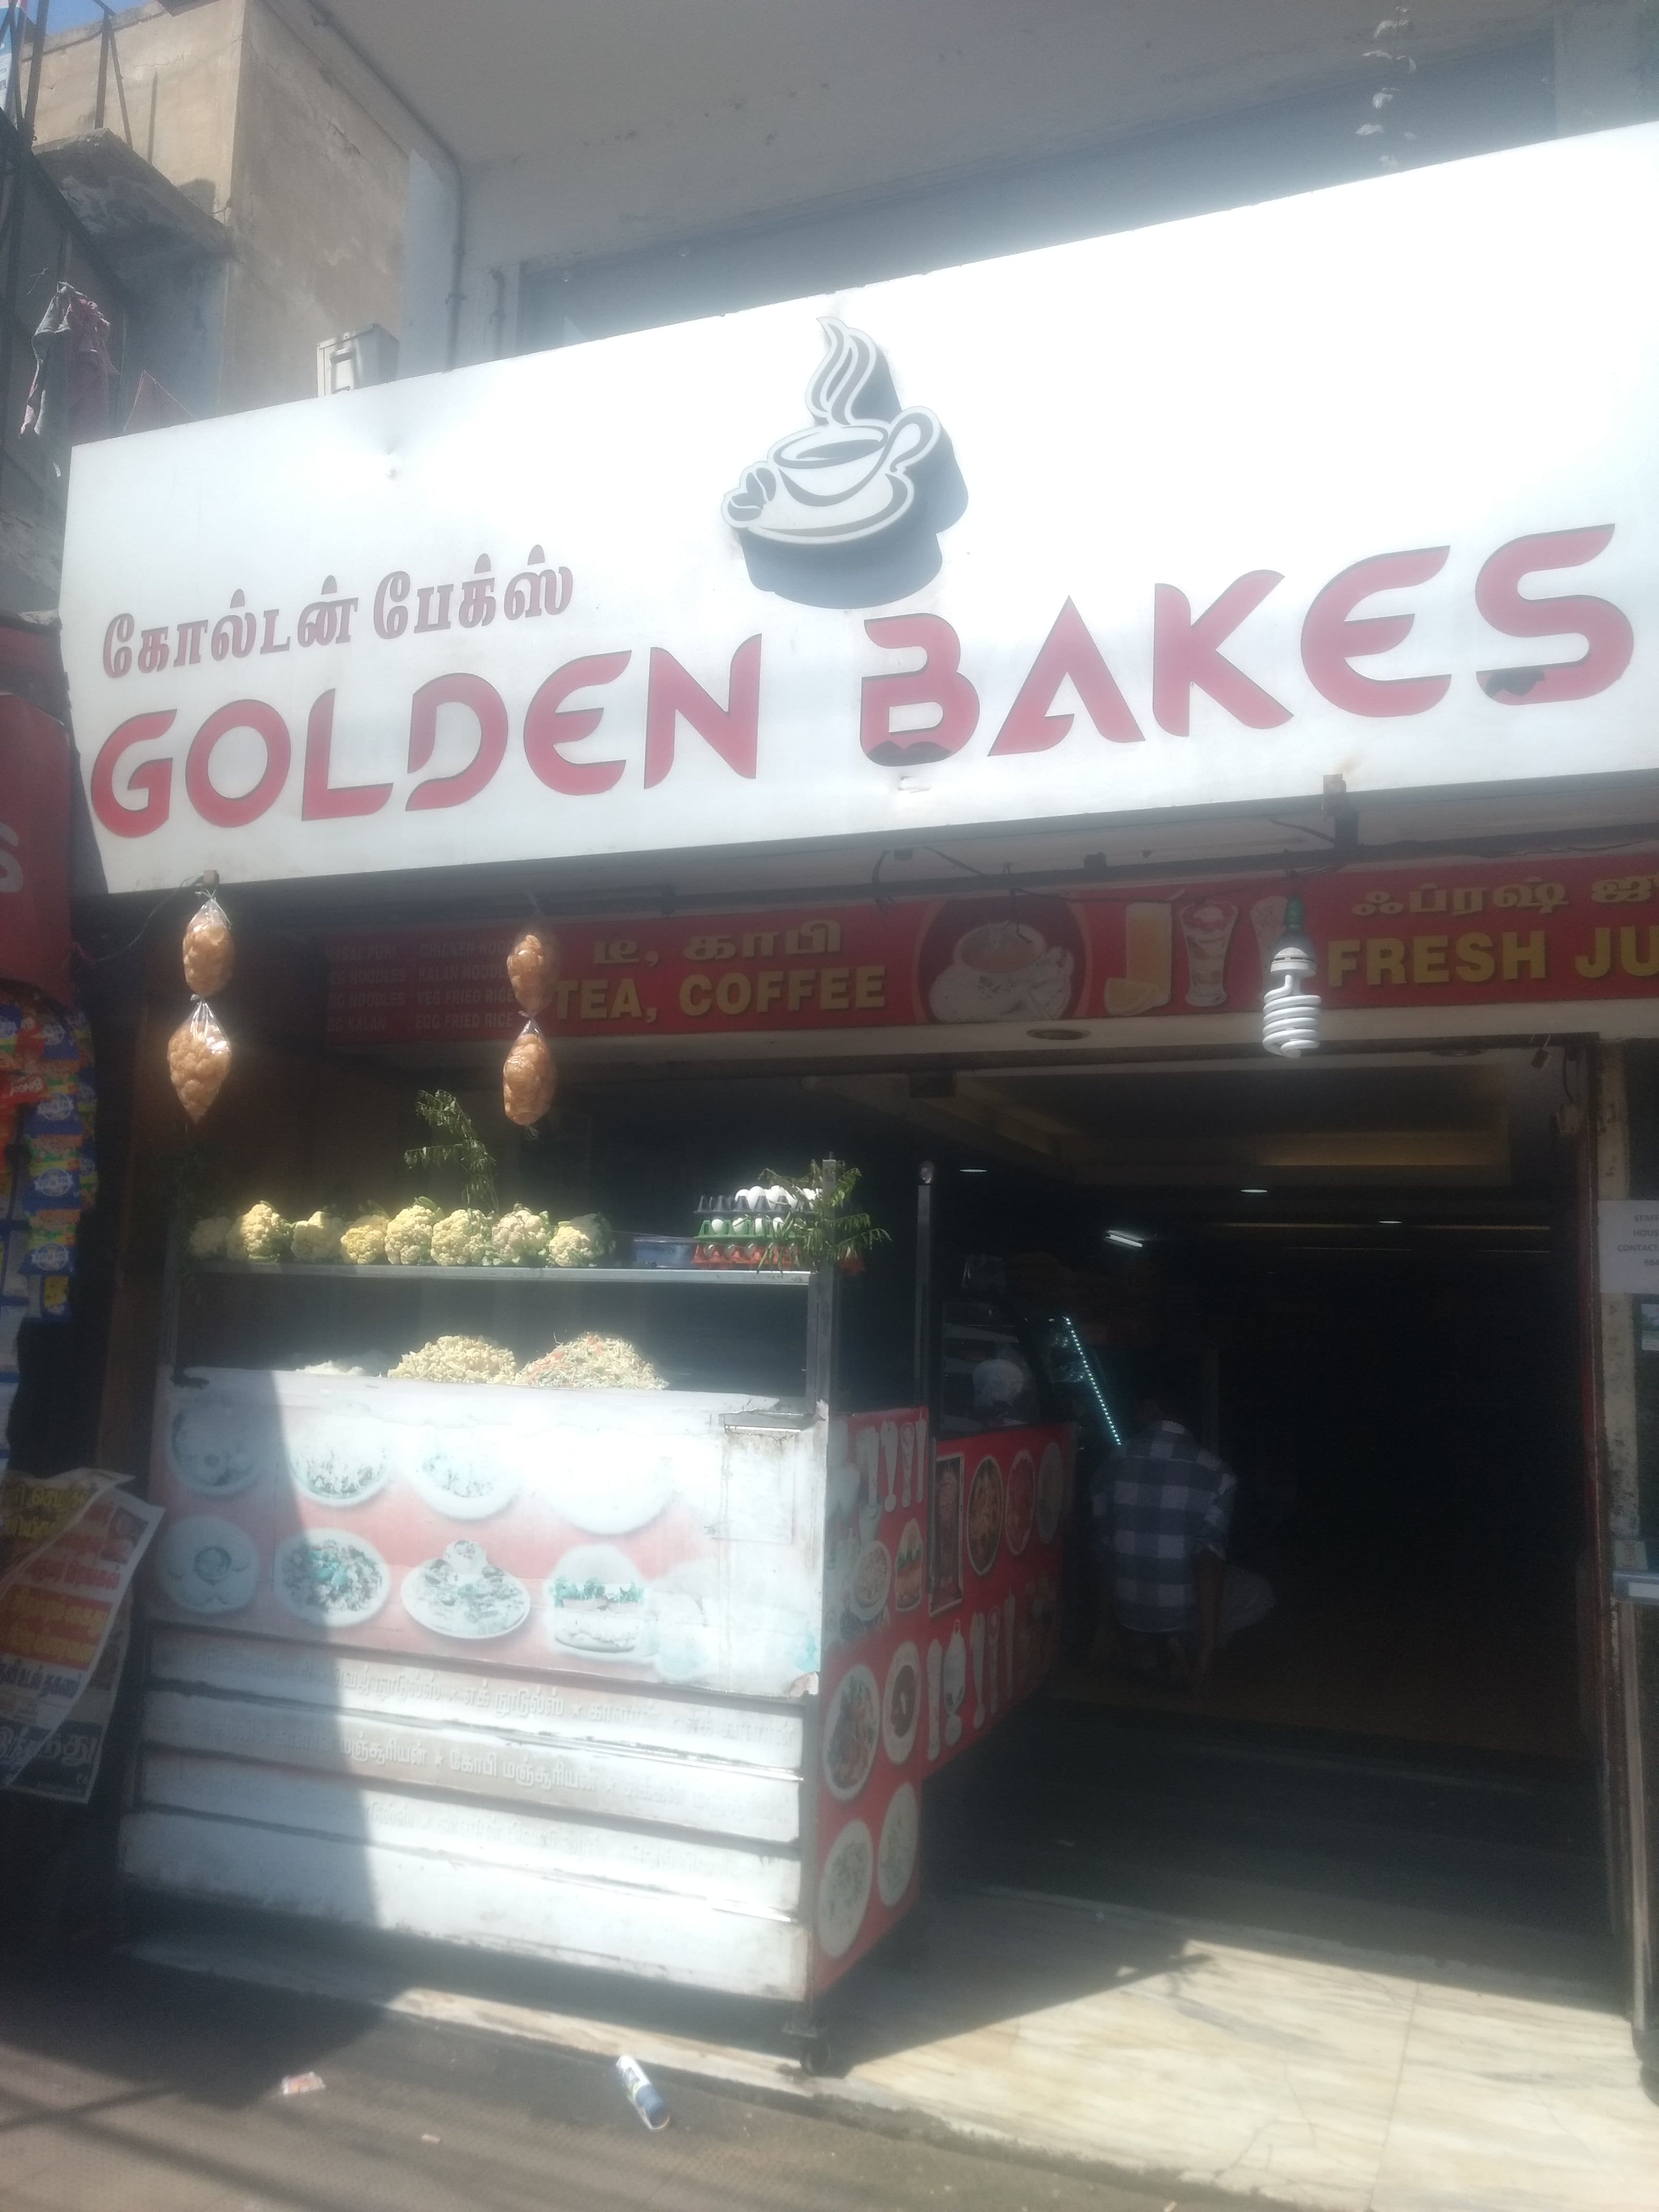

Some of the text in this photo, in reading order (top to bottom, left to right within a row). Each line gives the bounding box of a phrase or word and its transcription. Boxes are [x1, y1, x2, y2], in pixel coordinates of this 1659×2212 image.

[102, 544, 574, 678] கோல்டன் பேக்ஸ்
[90, 523, 1635, 839] GOLDEN BAKES
[420, 941, 475, 958] CHICKEN
[684, 919, 841, 961] காபி
[1327, 930, 1546, 987] FRESH
[417, 987, 516, 1006] VEG FRIED RICE
[555, 965, 886, 1023] TEA, COFFEE
[415, 1012, 514, 1030] EGG FRIED RICE
[450, 1748, 498, 1777] கோபி
